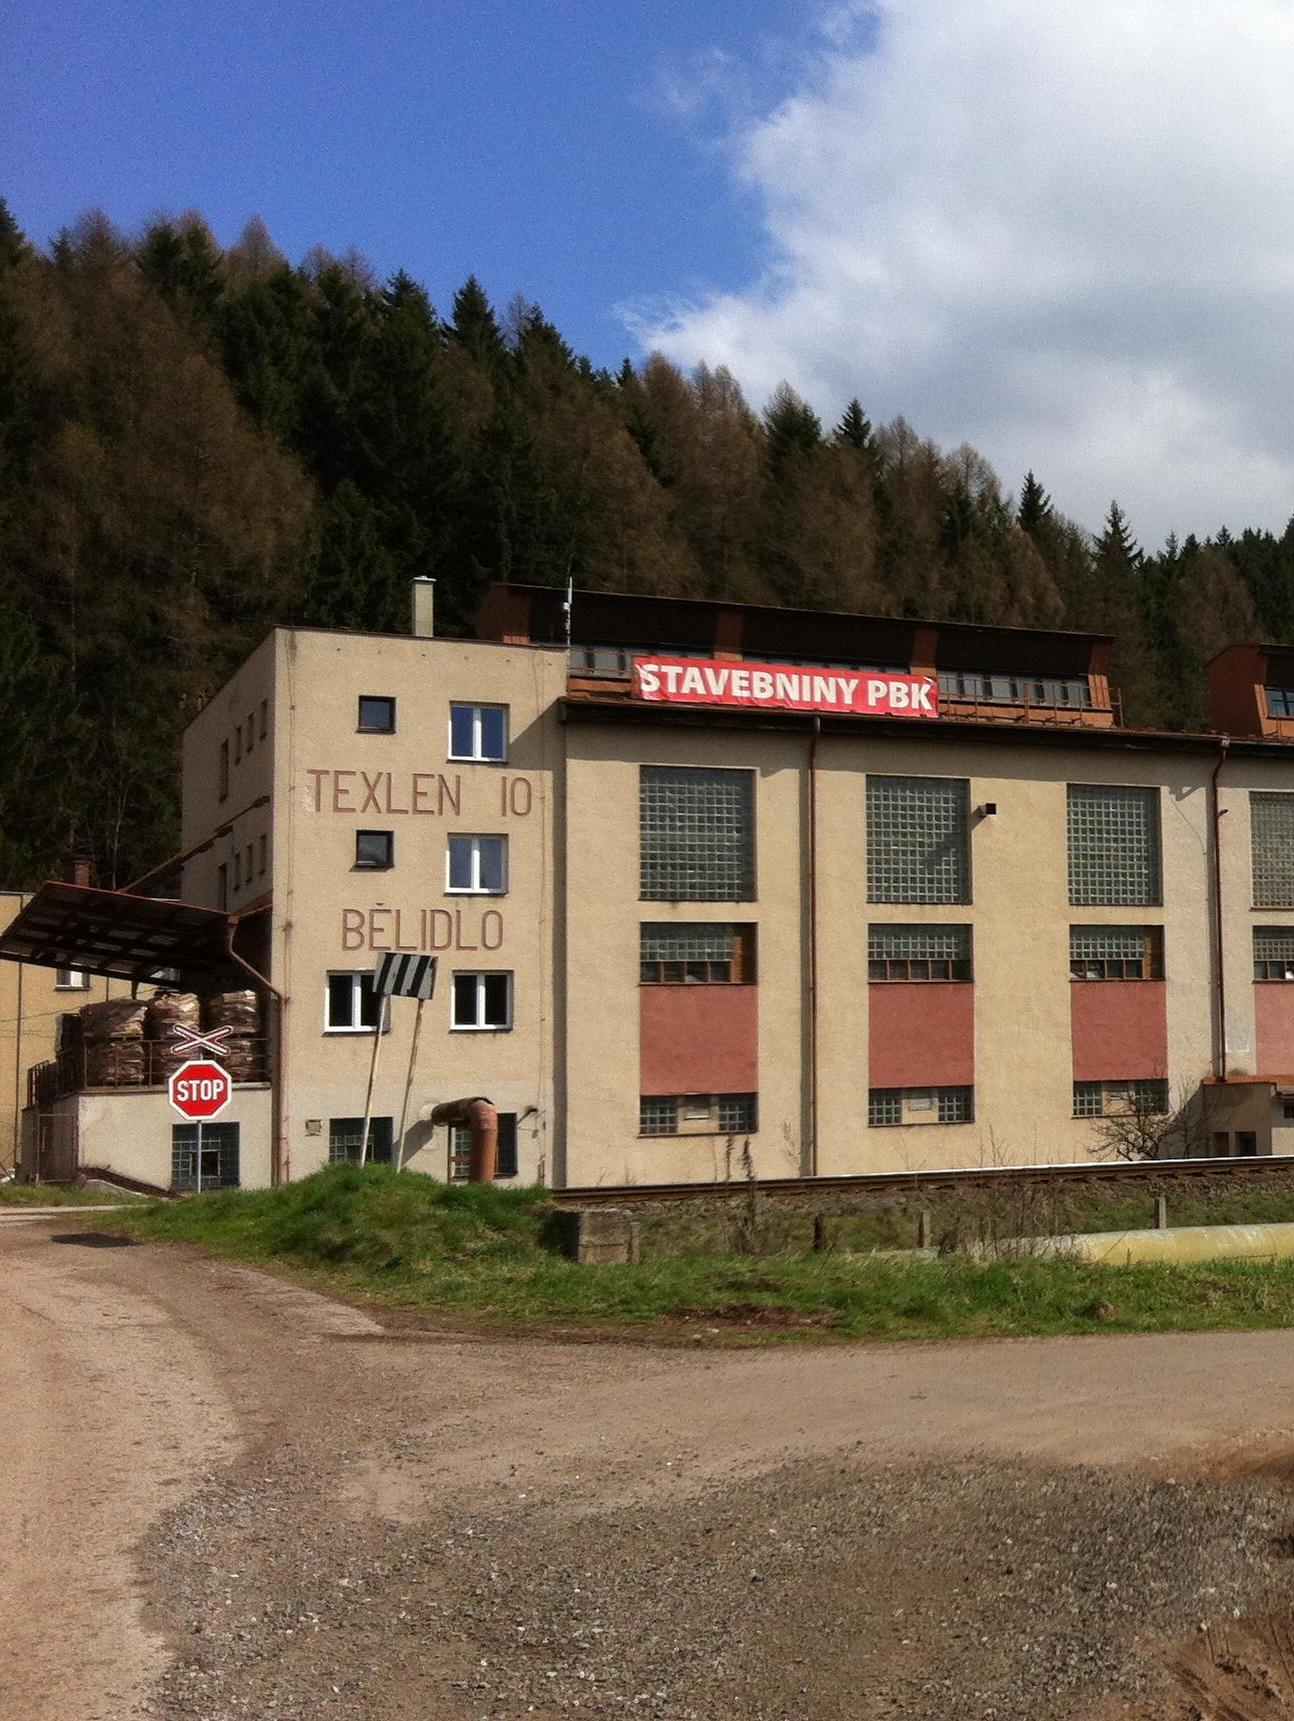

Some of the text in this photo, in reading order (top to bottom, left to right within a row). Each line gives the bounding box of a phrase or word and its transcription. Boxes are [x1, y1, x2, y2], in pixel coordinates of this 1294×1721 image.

[640, 663, 933, 710] STAVEBNINY PBK
[306, 769, 461, 816] TEXLEN
[176, 1079, 225, 1102] STOP
